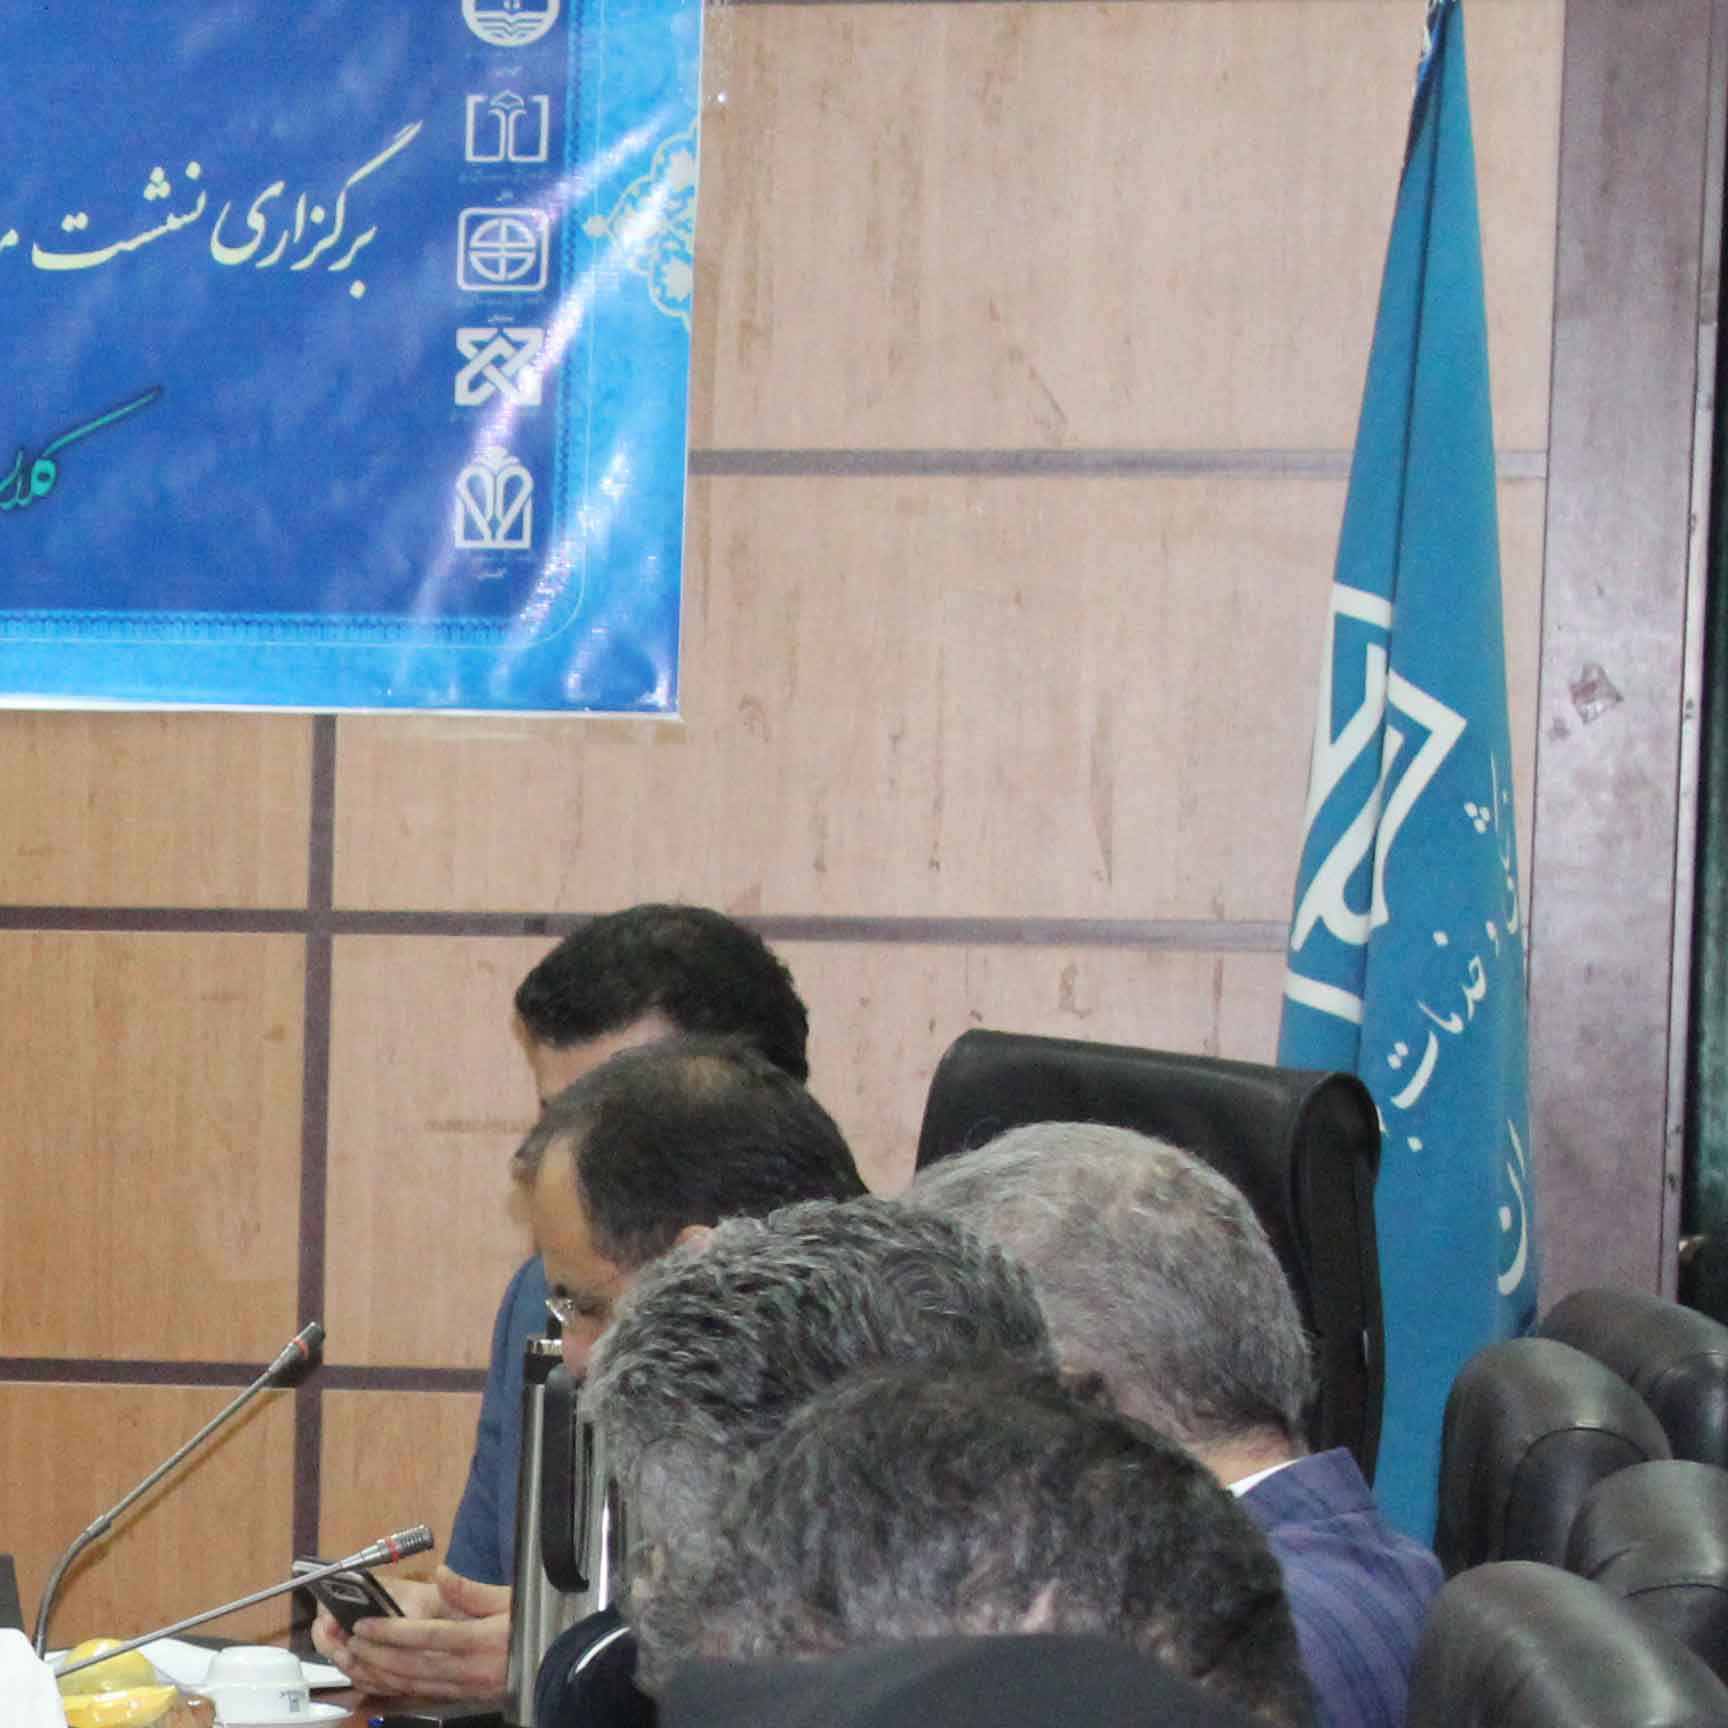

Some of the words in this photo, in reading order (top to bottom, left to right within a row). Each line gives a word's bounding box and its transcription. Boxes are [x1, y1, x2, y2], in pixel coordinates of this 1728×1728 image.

[31, 160, 207, 271] نشست
[210, 119, 424, 300] برگزاری
[1385, 928, 1489, 1111] خدمات
